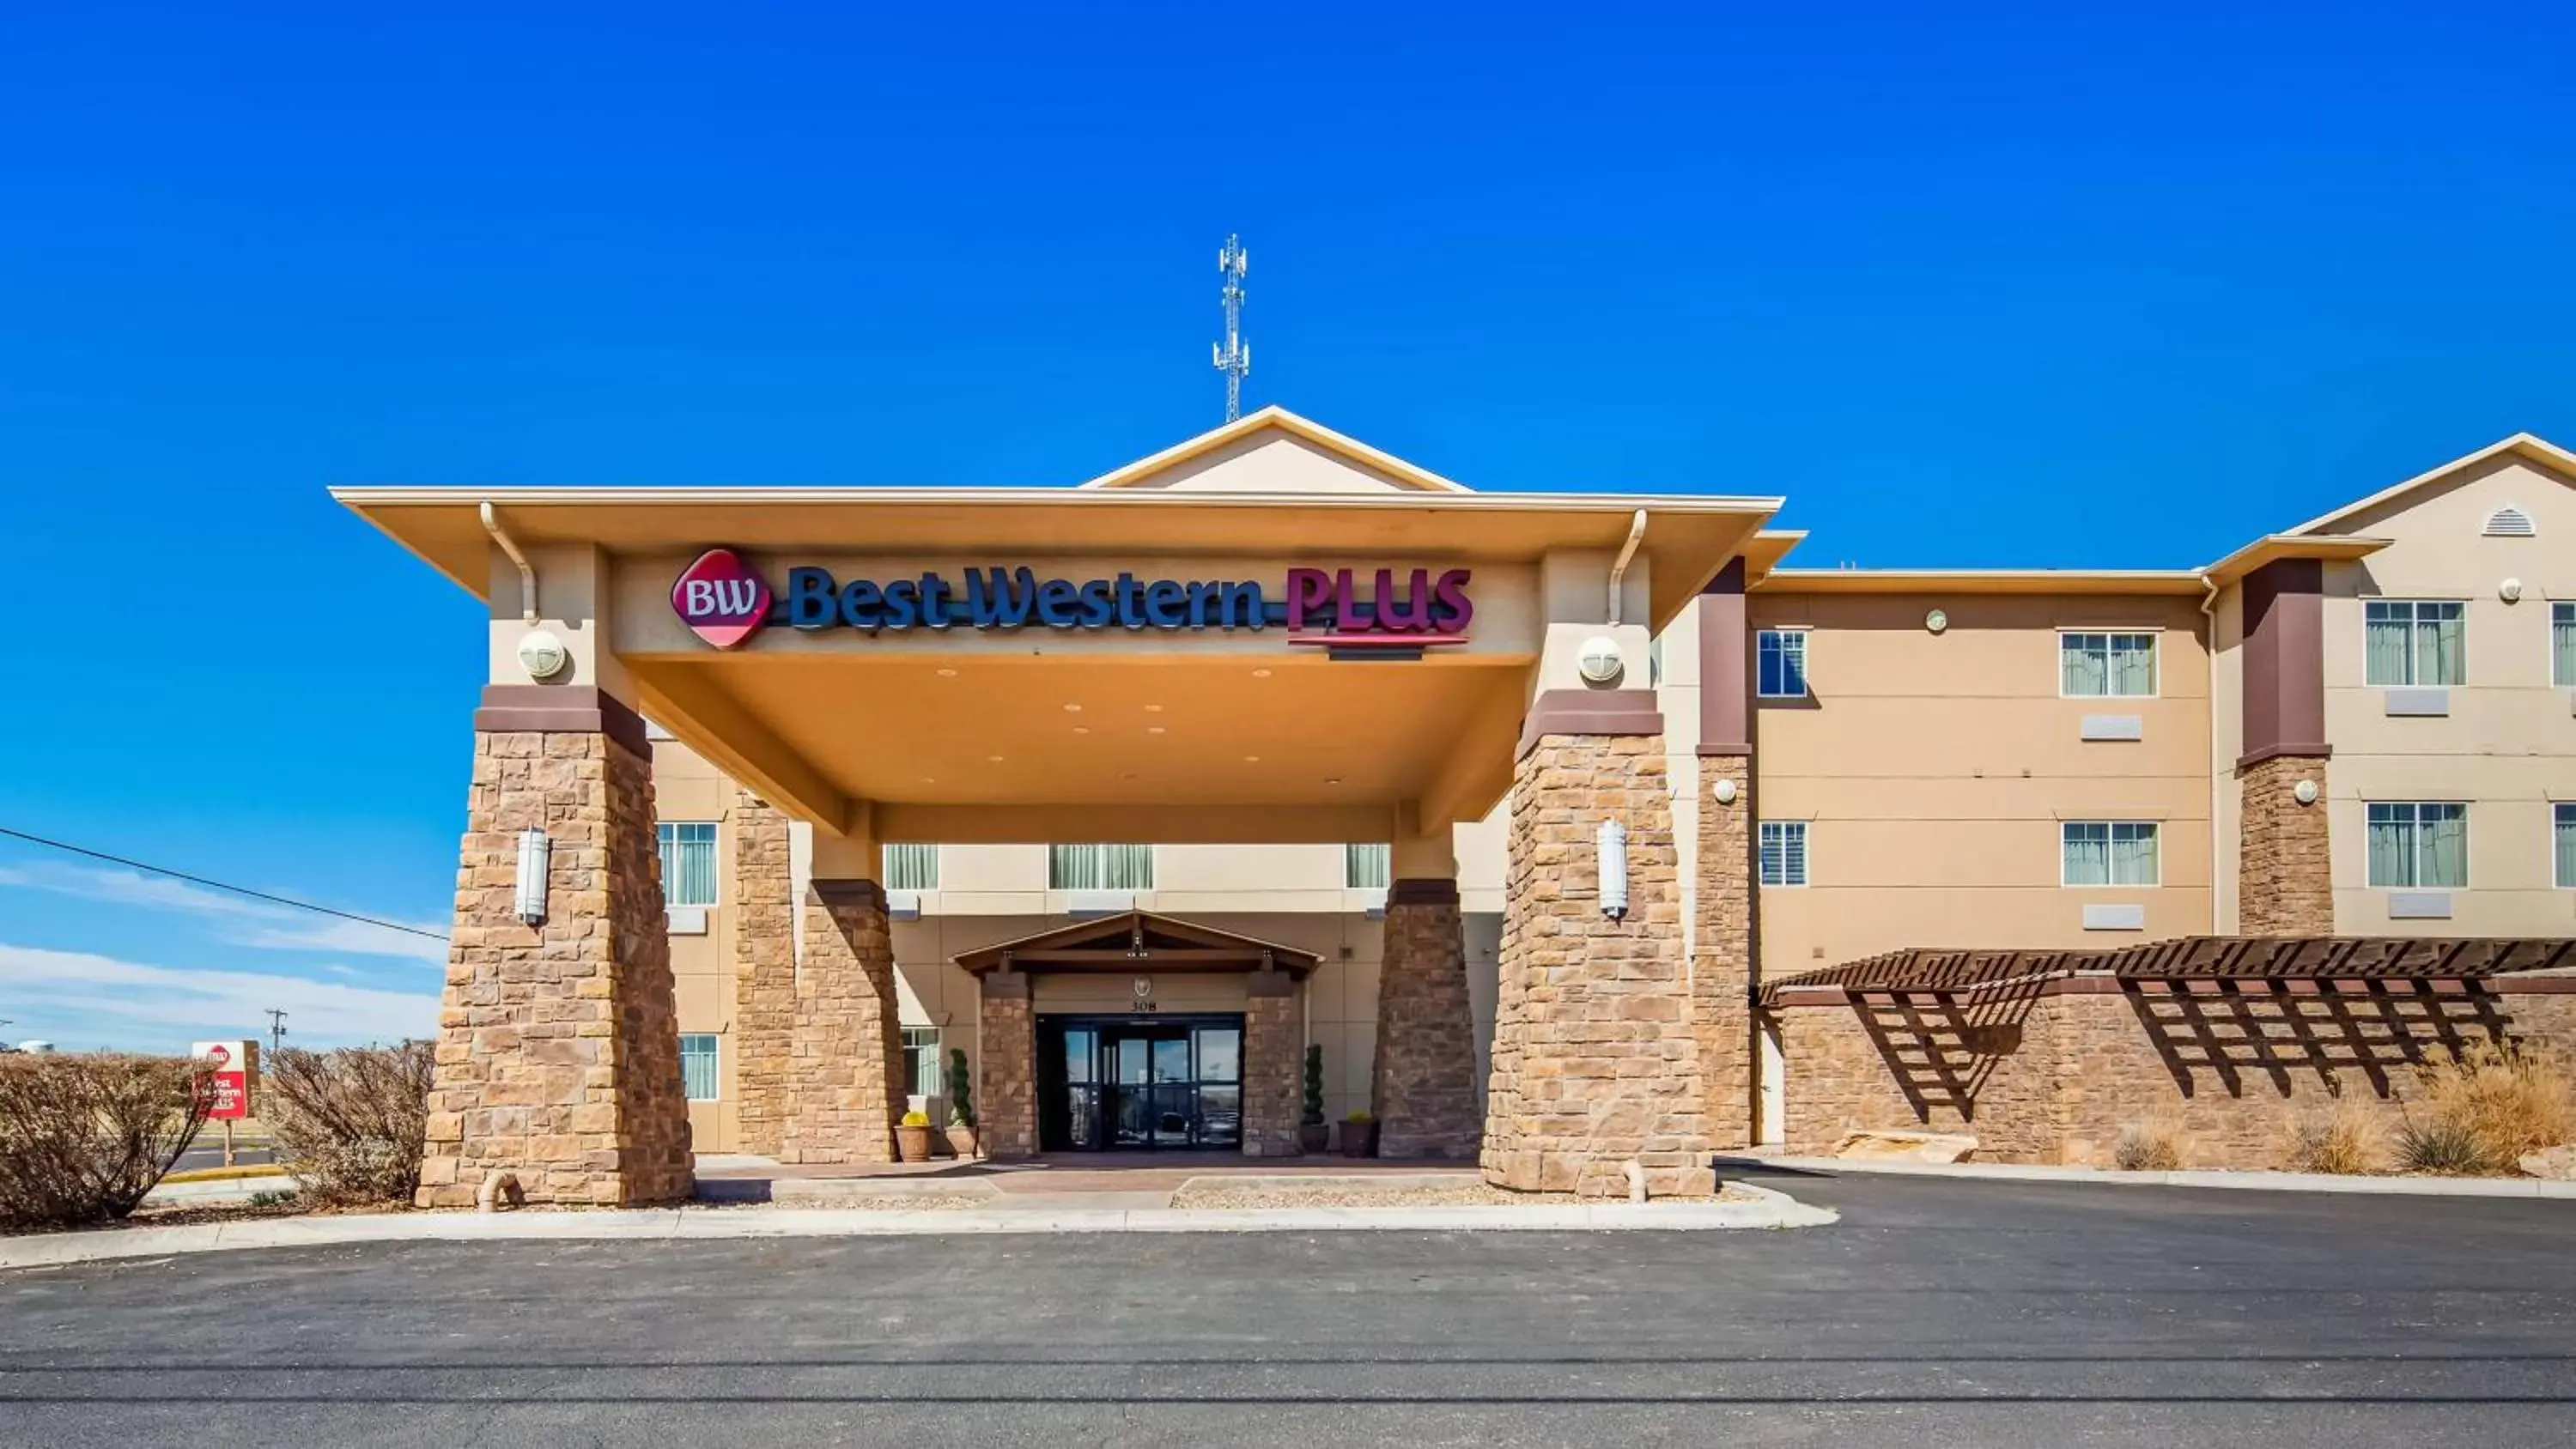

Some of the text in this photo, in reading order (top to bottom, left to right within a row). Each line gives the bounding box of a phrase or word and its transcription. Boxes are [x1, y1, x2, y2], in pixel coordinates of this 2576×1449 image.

[687, 579, 757, 617] BW
[787, 566, 1473, 634] Best Western PLUS
